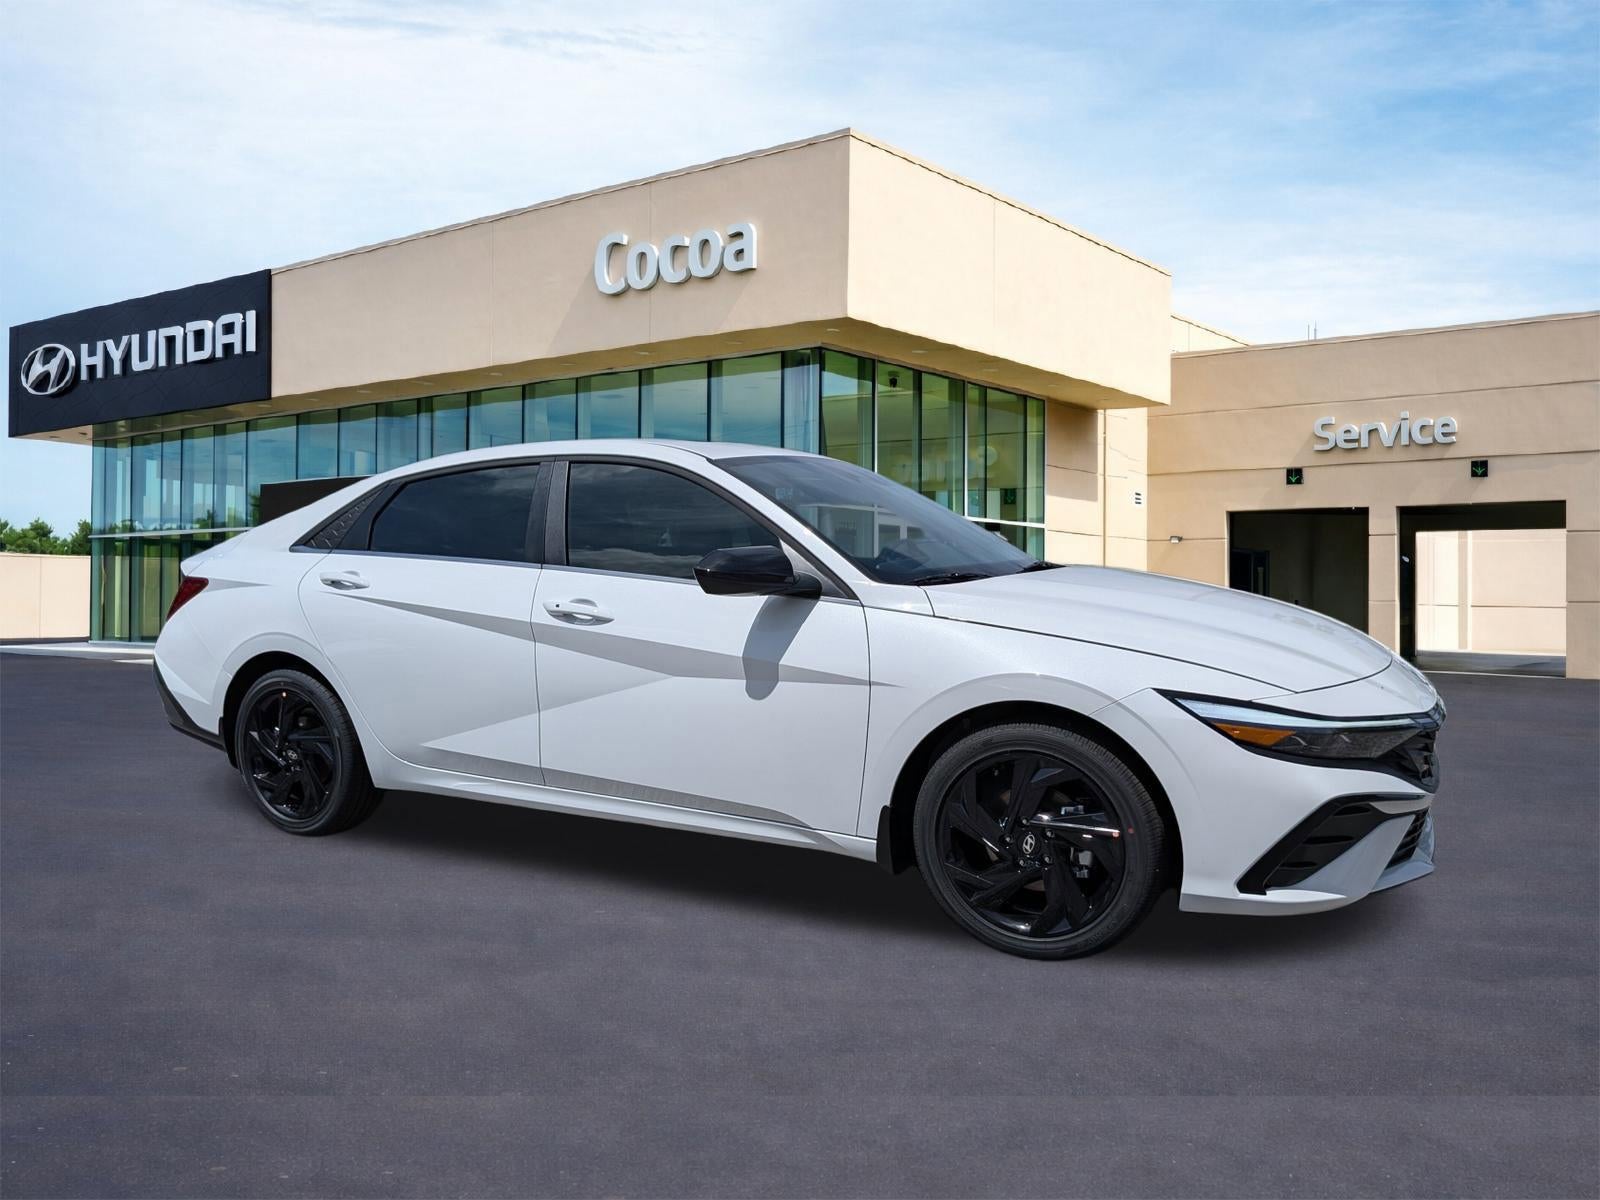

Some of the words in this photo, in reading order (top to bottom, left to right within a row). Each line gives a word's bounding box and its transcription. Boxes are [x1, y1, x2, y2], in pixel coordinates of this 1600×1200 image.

[594, 222, 758, 296] Cocoa
[79, 309, 257, 382] HYUNDAI
[1312, 410, 1458, 452] Service
